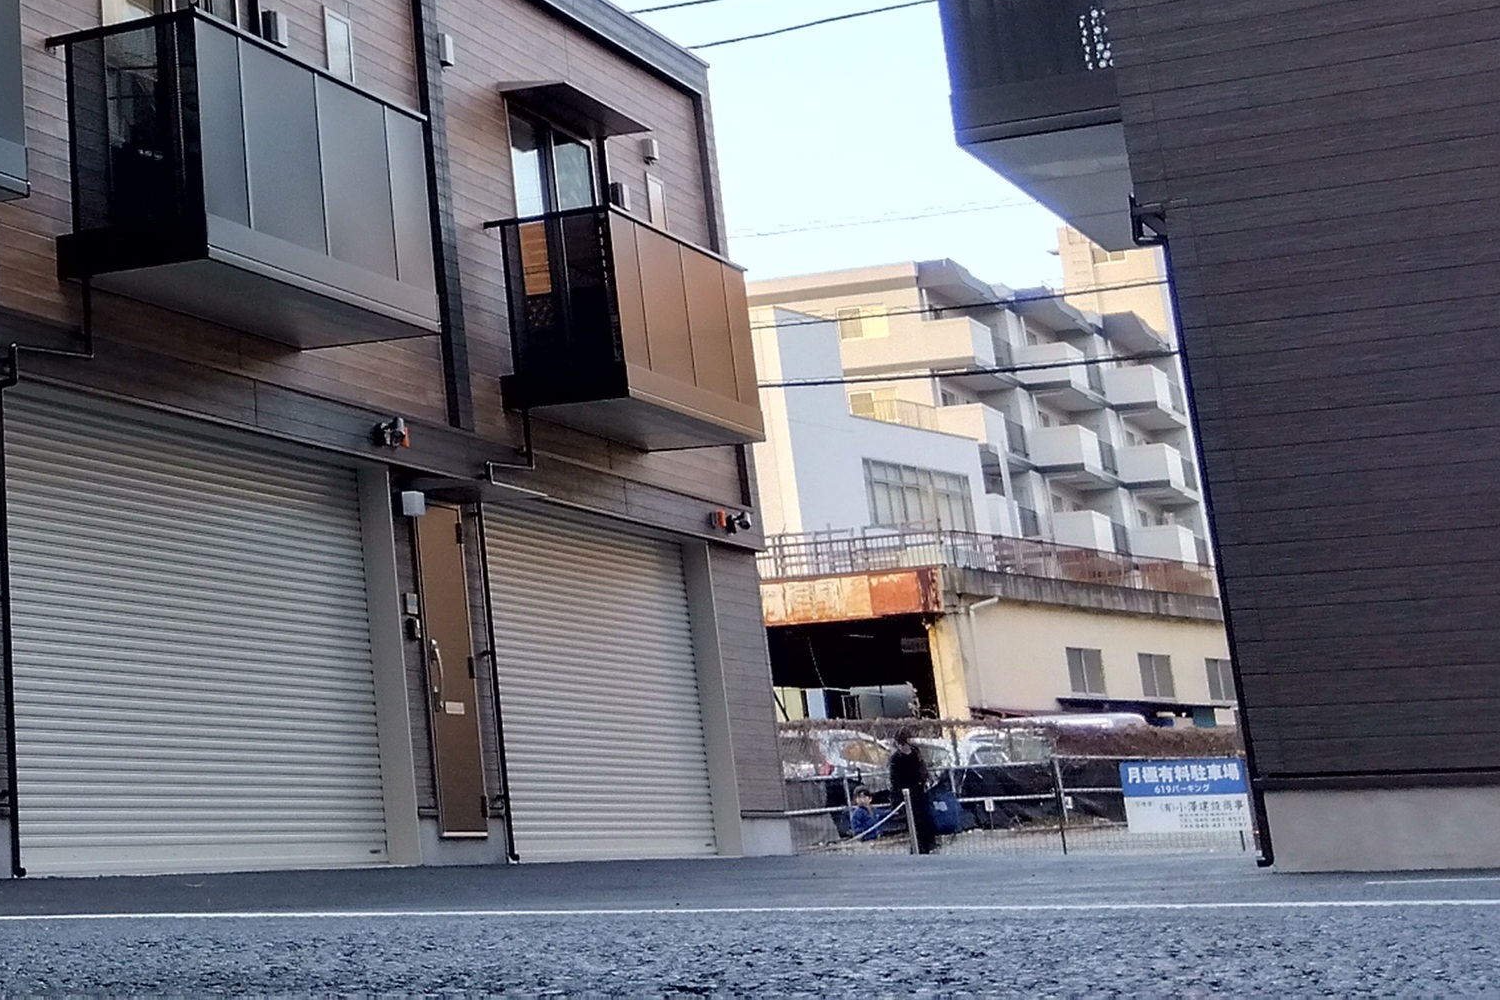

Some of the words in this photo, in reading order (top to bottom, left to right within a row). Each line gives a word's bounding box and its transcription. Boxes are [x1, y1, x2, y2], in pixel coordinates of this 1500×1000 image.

[1127, 763, 1240, 783] 月極有料駐車場
[1154, 784, 1210, 794] 619パーキング
